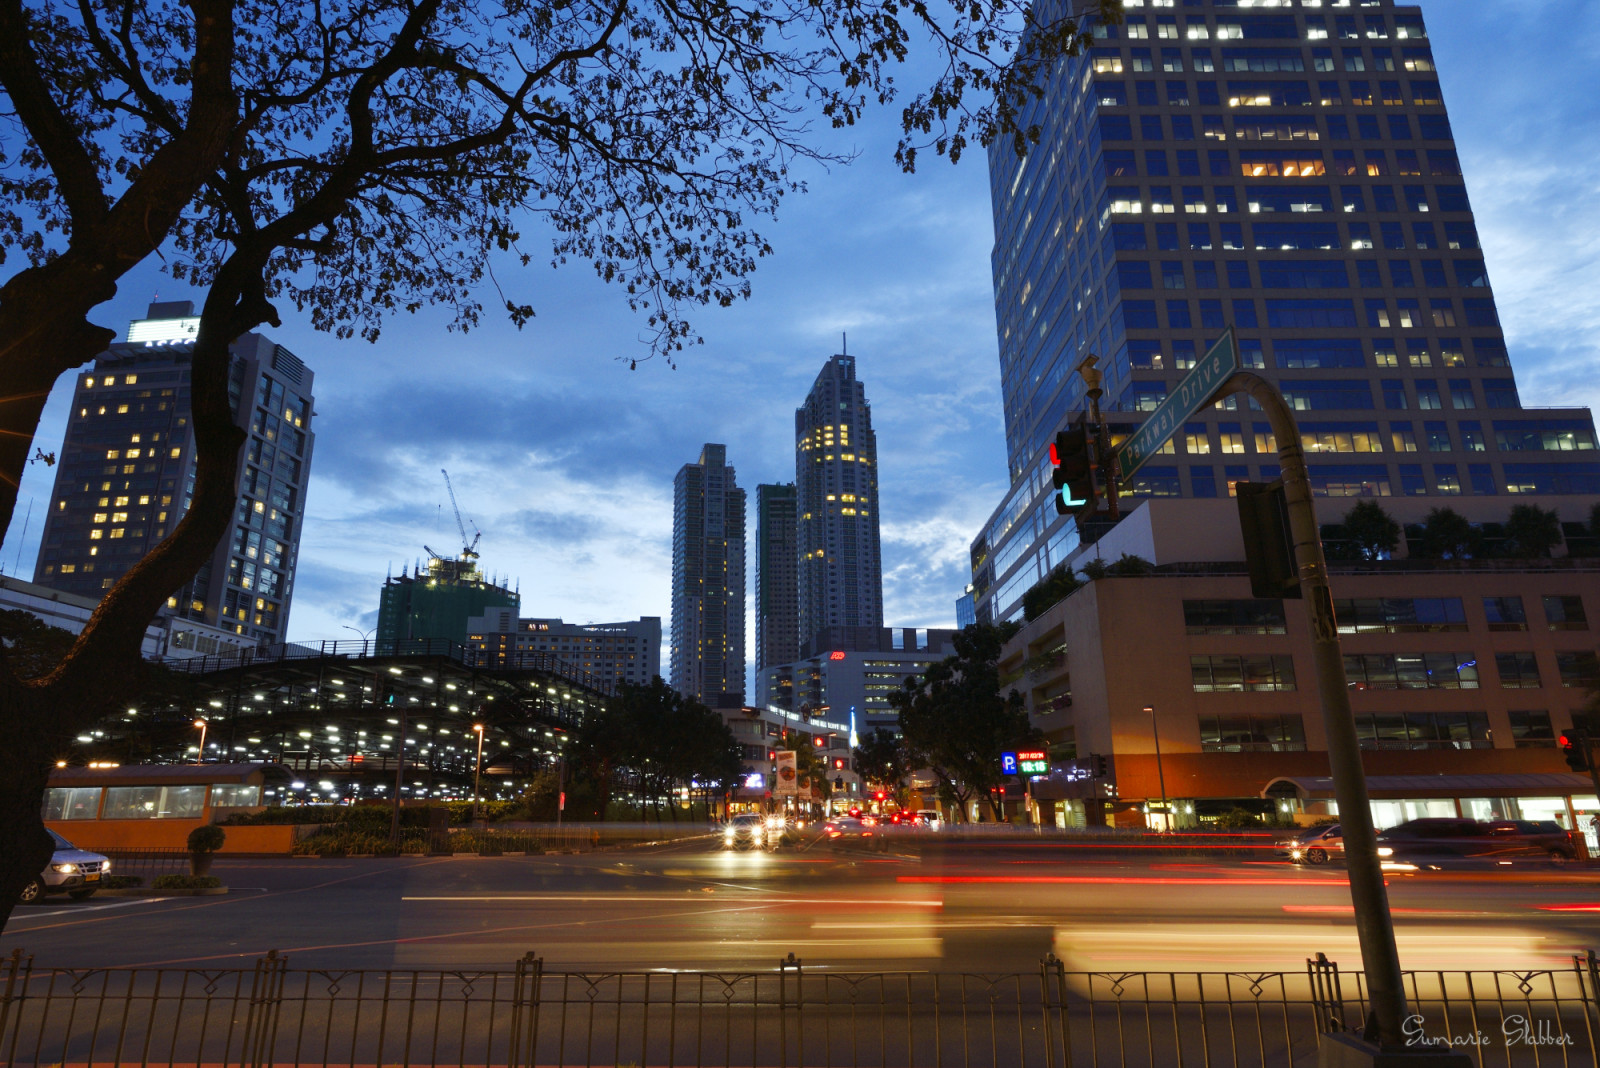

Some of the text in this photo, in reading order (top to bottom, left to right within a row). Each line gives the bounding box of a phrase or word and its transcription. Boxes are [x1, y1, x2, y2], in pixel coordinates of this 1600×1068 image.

[1126, 357, 1220, 465] Parkway Drive
[1004, 756, 1014, 770] P
[1021, 761, 1046, 772] 18:18
